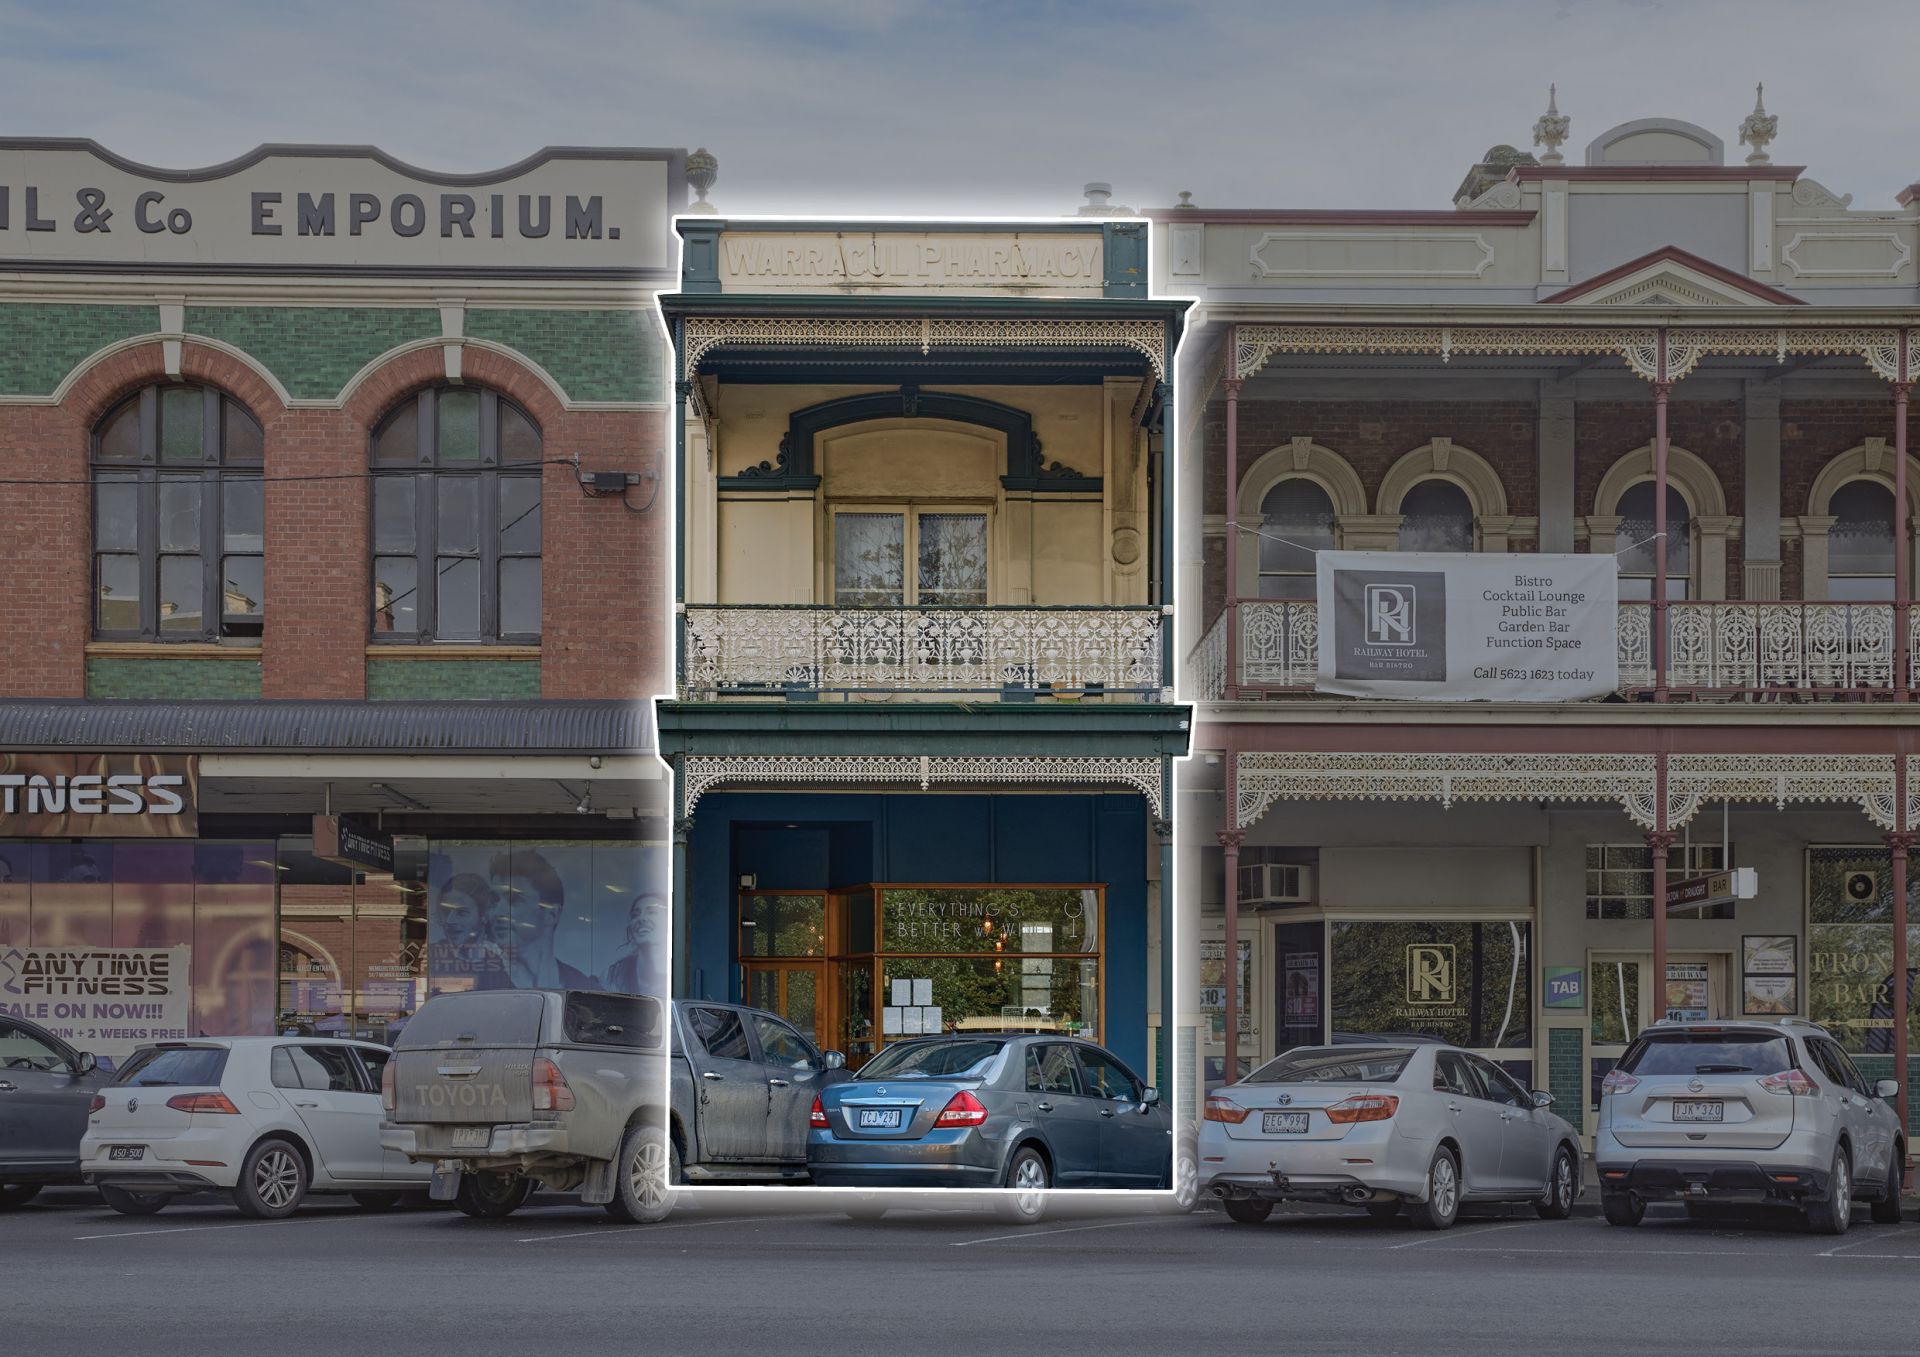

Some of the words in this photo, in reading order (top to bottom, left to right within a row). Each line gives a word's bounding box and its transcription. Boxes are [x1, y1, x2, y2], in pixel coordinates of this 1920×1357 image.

[74, 187, 113, 233] &
[134, 191, 192, 234] Co
[252, 192, 621, 240] EMPORIUM.
[917, 243, 1098, 278] PHARMACY
[1515, 575, 1553, 587] Bistro
[1483, 590, 1535, 601] Cocktail
[1538, 590, 1585, 604] Lounge
[1502, 605, 1542, 617] Public
[1545, 605, 1567, 617] Bar
[1498, 620, 1545, 632] Garden
[1549, 621, 1571, 632] Bar
[1486, 636, 1543, 648] Function
[1546, 636, 1582, 651] Space
[1353, 647, 1393, 657] RAILWAY
[1396, 648, 1428, 658] HOTEL
[1473, 666, 1497, 678] Call
[1500, 668, 1527, 680] 5623
[1530, 669, 1555, 680] 1623
[1558, 668, 1595, 681] today
[0, 774, 184, 814] TNESS
[1713, 879, 1727, 892] BAR
[898, 902, 1019, 918] EVERYTHINGS
[898, 922, 961, 938] BETTER
[21, 953, 169, 976] ANYTIME
[1811, 952, 1895, 973] FRON
[24, 977, 169, 996] FITNESS
[1551, 981, 1579, 995] TAB
[1834, 983, 1889, 1004] BAR
[54, 1003, 87, 1019] ON
[92, 1003, 164, 1019] NOW!!!
[1395, 1007, 1434, 1017] RAILWAY
[1437, 1007, 1468, 1016] HOTEL
[48, 1028, 74, 1039] OIN
[88, 1029, 96, 1039] 2
[99, 1029, 148, 1039] WEEKS
[151, 1029, 185, 1039] FREE
[415, 1083, 507, 1106] TOYOTA
[862, 1111, 878, 1123] YCJ
[883, 1111, 899, 1123] 291
[1265, 1115, 1283, 1127] ZEG
[1289, 1115, 1307, 1127] 994
